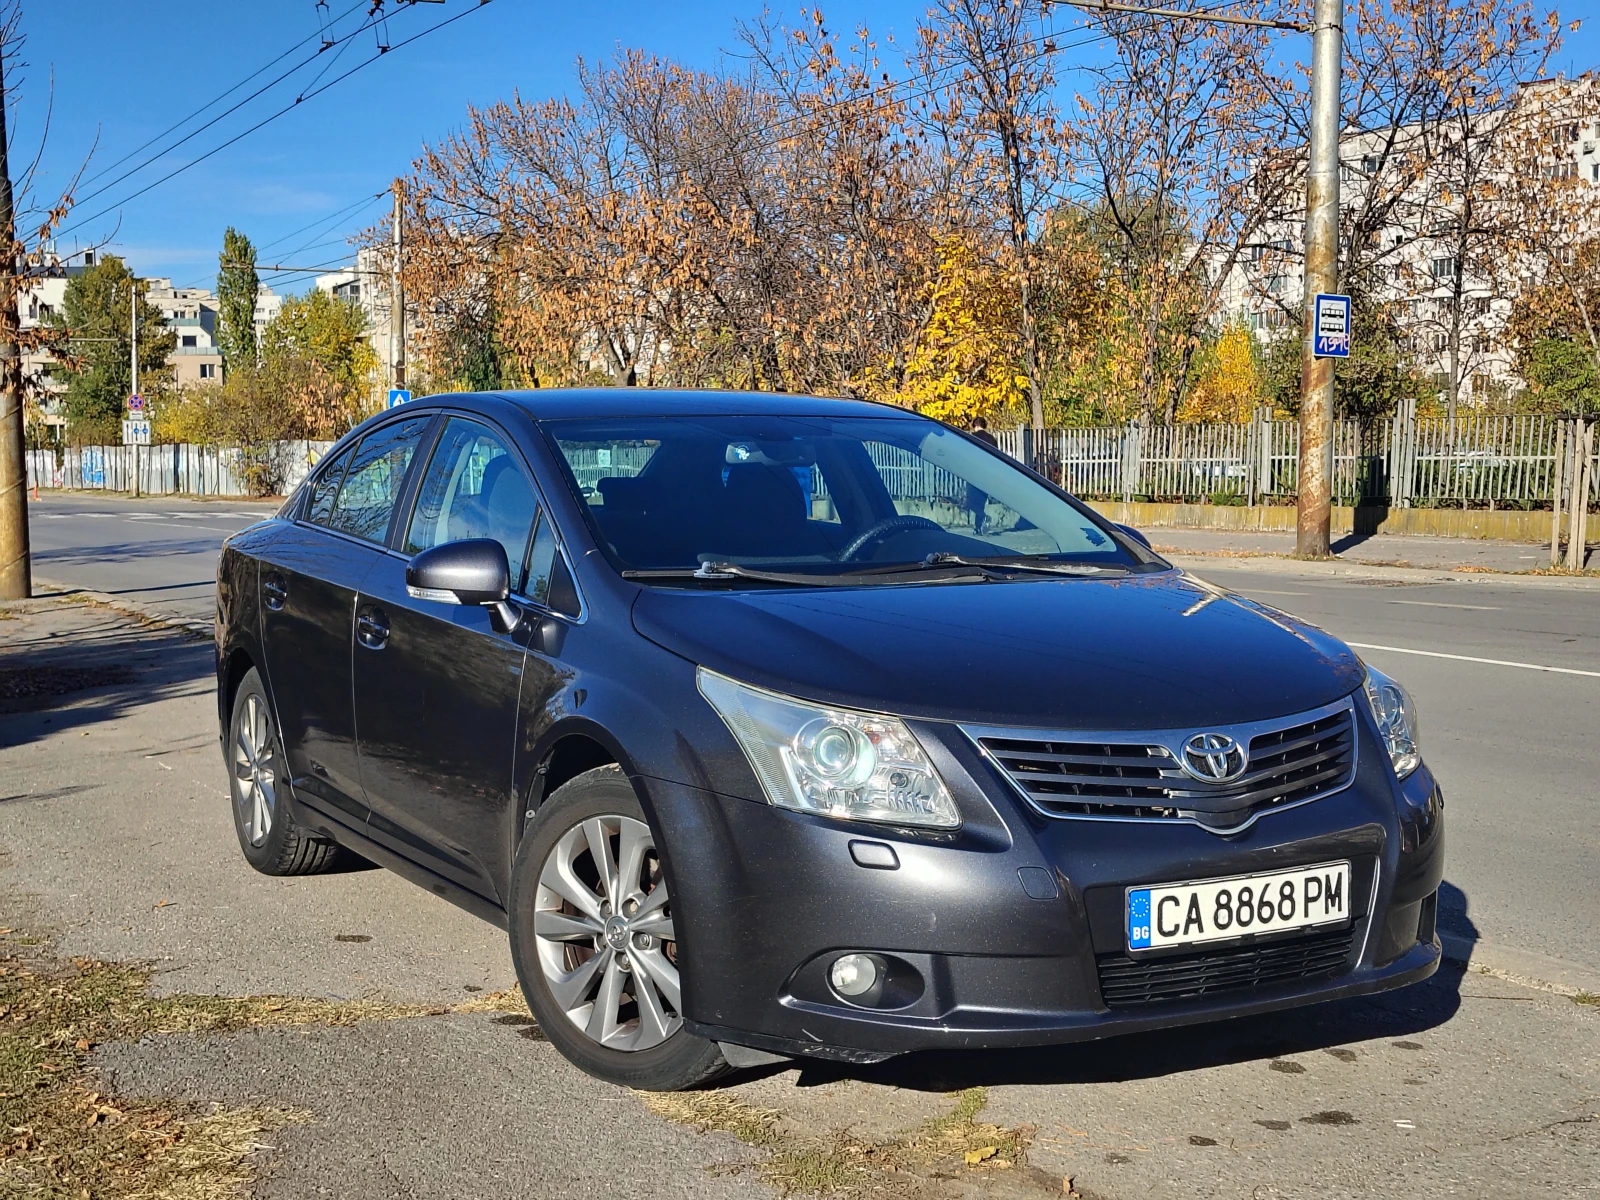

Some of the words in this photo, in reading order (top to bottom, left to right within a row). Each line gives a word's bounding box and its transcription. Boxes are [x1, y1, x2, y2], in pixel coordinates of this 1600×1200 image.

[1157, 893, 1204, 937] CA
[1213, 880, 1296, 930] 8868
[1303, 872, 1343, 918] PM
[1132, 926, 1149, 941] BG
